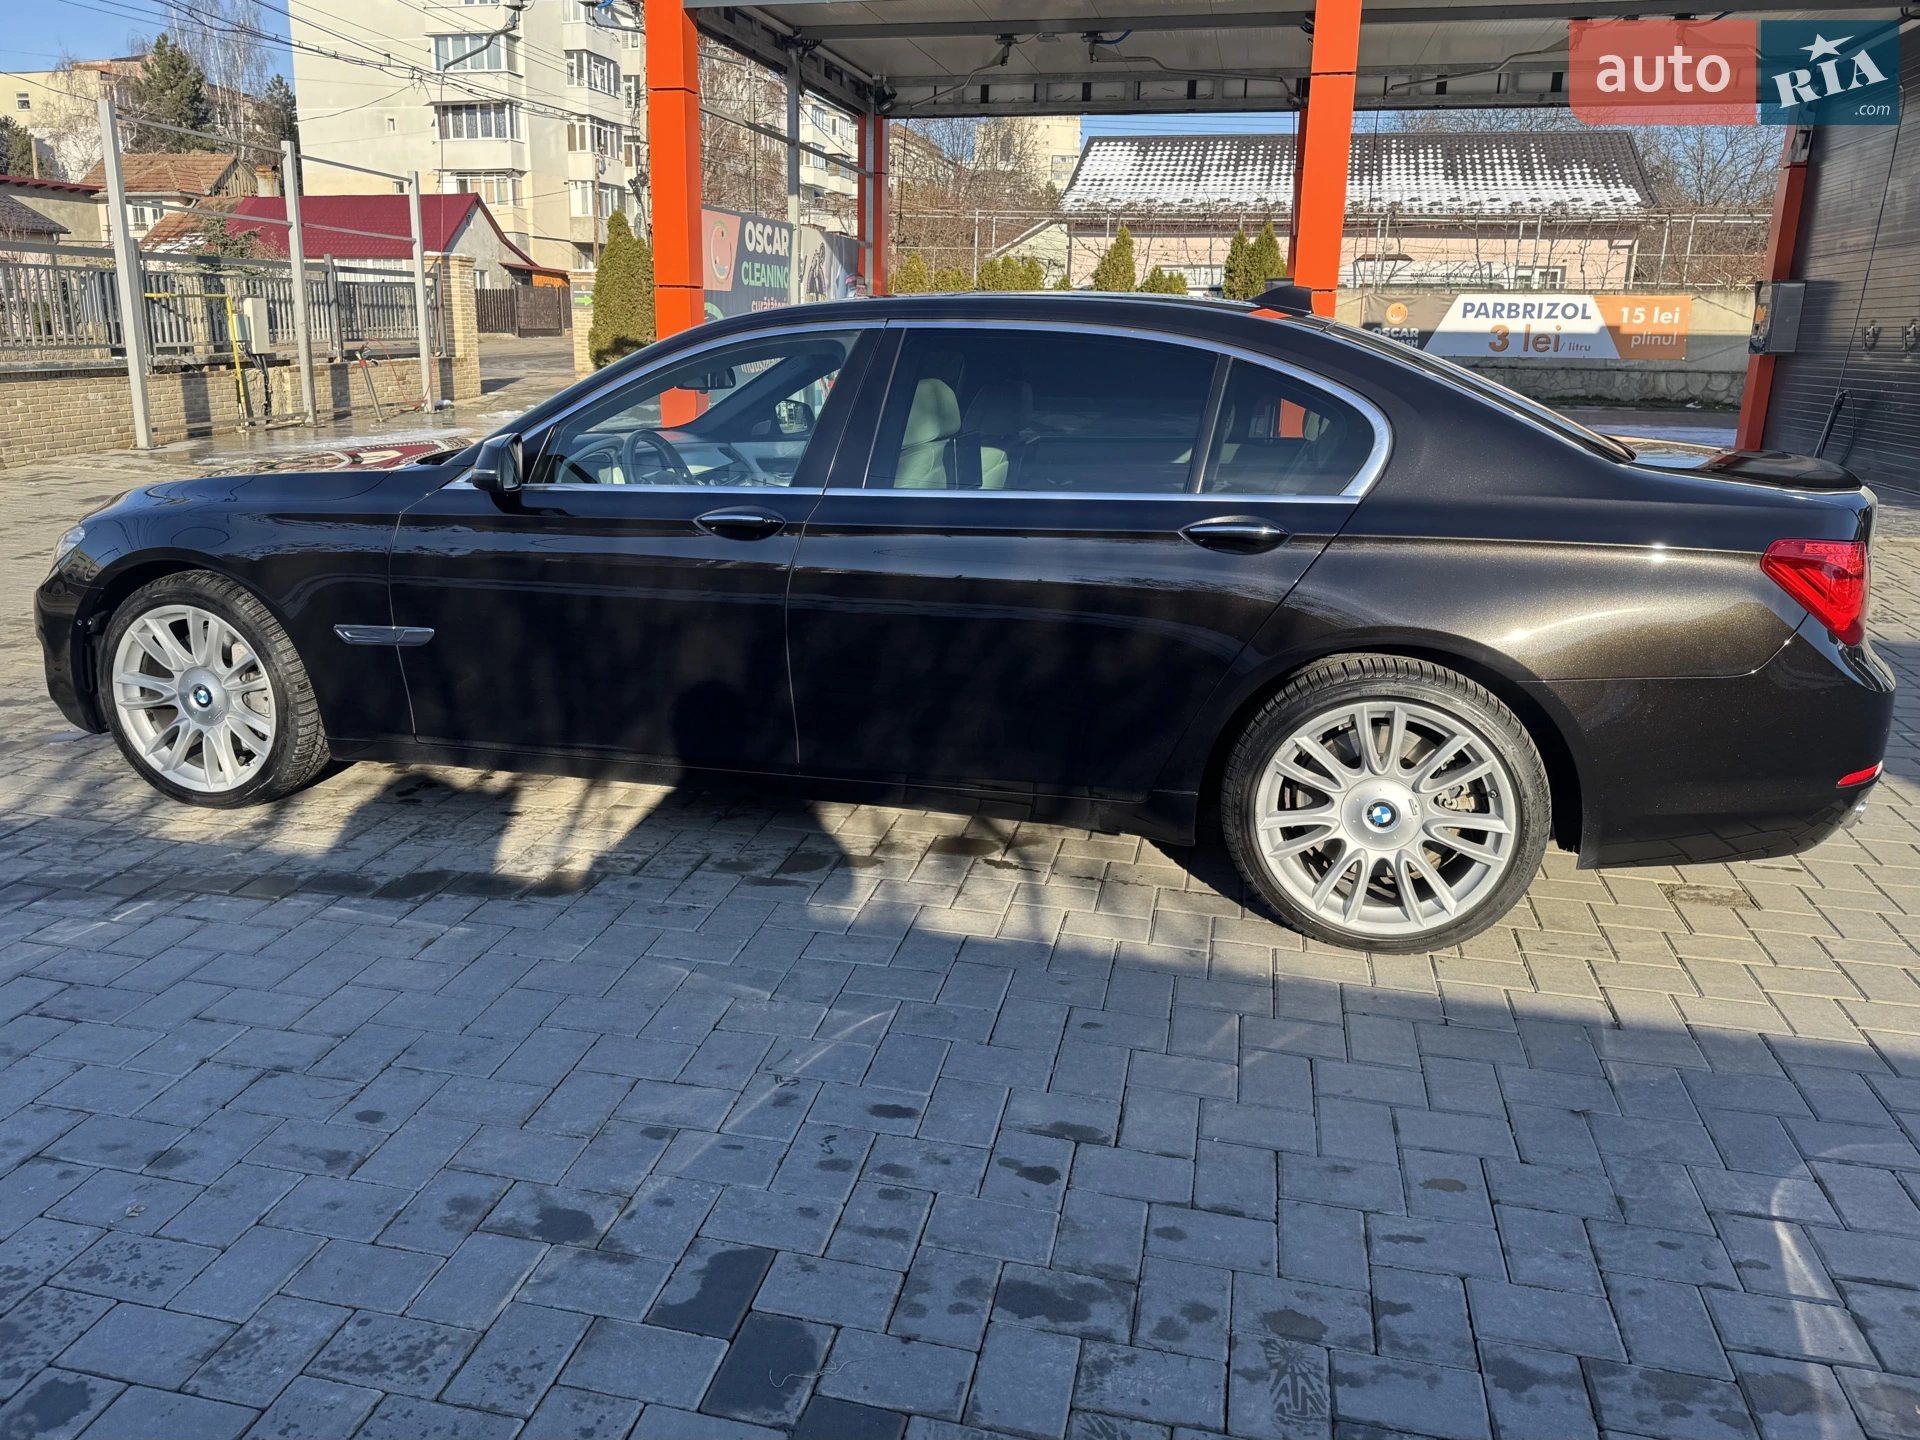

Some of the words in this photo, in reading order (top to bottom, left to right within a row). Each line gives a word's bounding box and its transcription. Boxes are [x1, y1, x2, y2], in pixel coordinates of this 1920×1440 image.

[744, 220, 790, 257] OSCAR
[741, 260, 789, 289] CLEANING
[1461, 302, 1592, 320] PARBRIZOL
[1620, 306, 1646, 325] 15
[1652, 306, 1681, 325] lei
[1371, 327, 1420, 338] OSCAR
[1488, 324, 1510, 353] 3
[1523, 323, 1562, 353] lei
[1630, 331, 1678, 349] plinul
[1396, 339, 1418, 348] ASH
